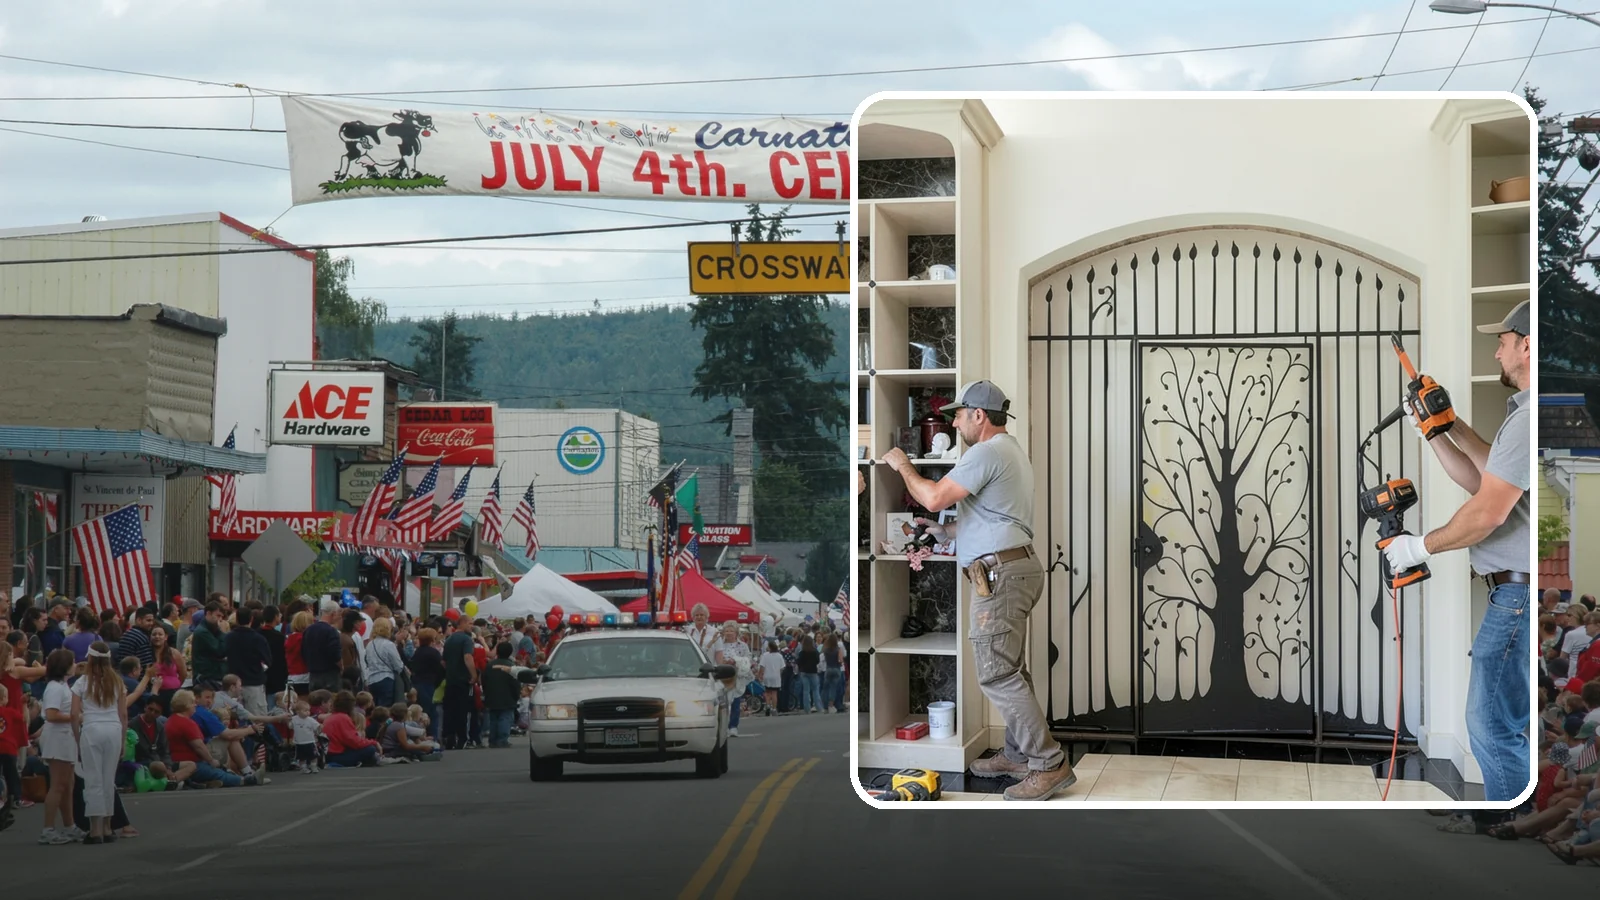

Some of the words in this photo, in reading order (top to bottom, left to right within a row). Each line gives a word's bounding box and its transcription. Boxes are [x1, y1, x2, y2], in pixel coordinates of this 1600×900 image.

[481, 141, 605, 192] JULY
[632, 150, 746, 198] 4th.
[697, 254, 850, 280] CROSSWA
[283, 380, 373, 420] ACE
[405, 409, 453, 422] CEDAR
[283, 421, 371, 436] Hardware
[416, 428, 477, 447] Coca-Cola
[96, 485, 124, 495] Vincent
[126, 486, 136, 494] de
[138, 486, 155, 495] Paul
[699, 535, 730, 543] GLASS
